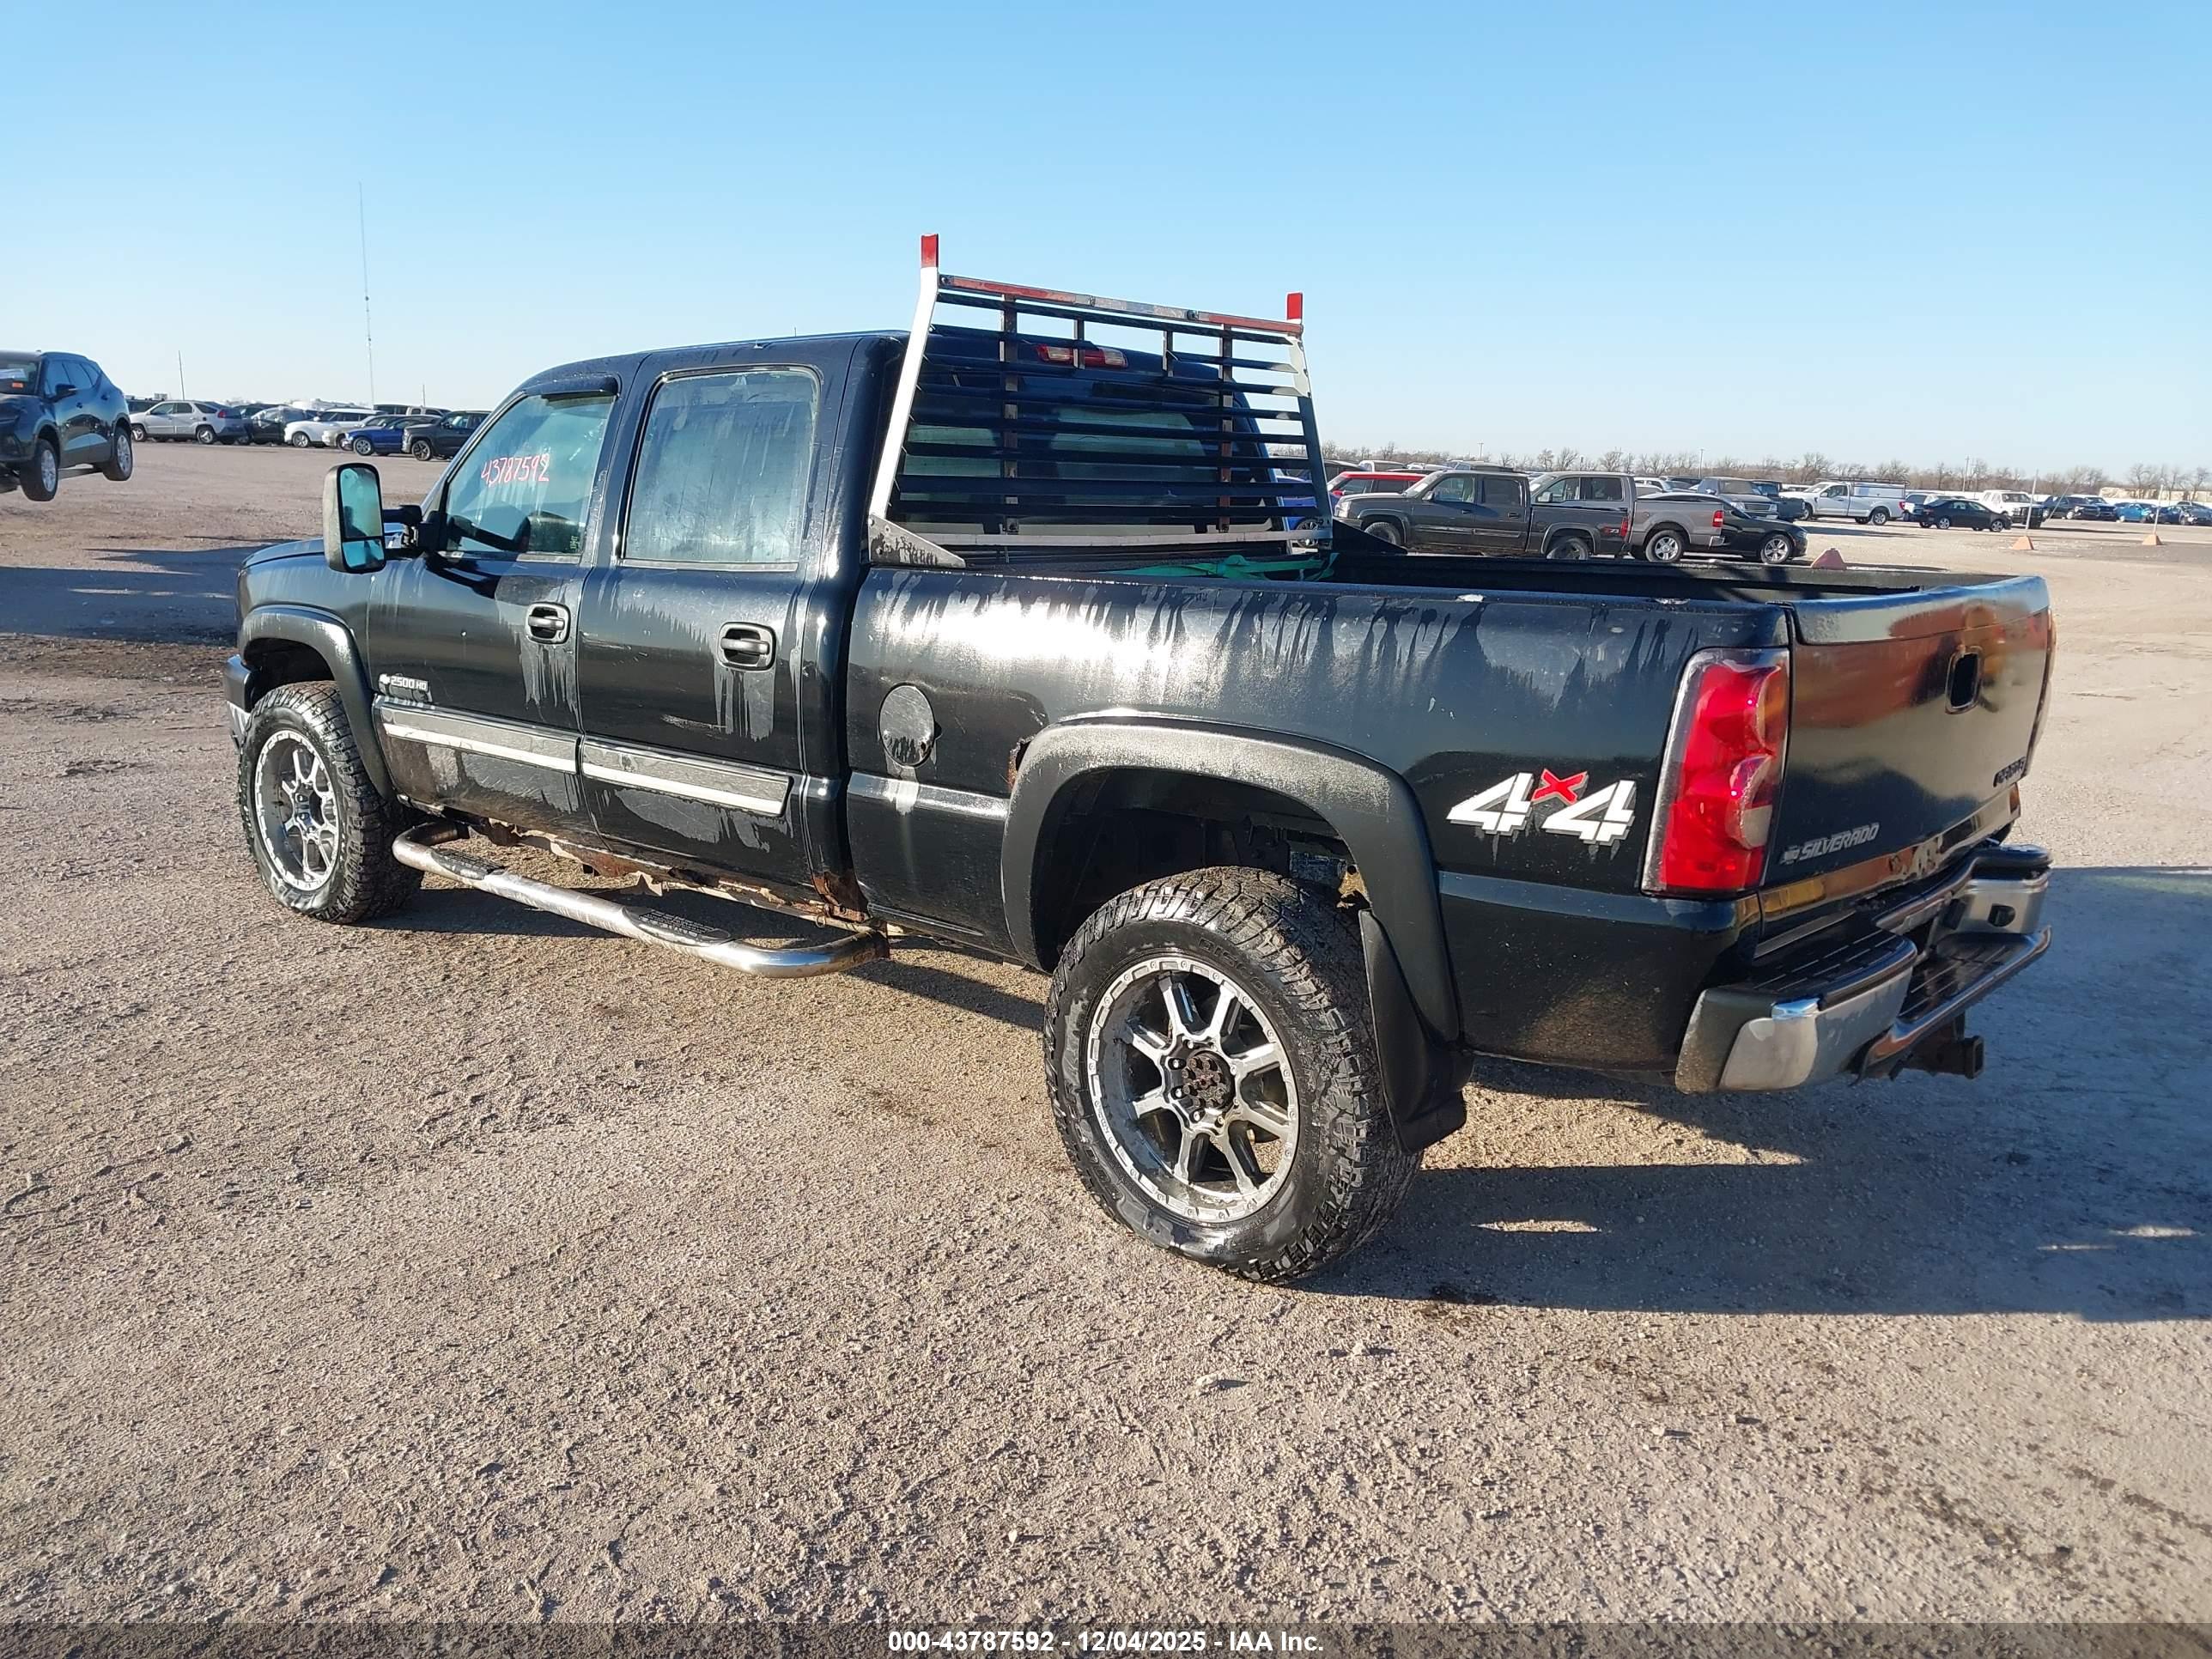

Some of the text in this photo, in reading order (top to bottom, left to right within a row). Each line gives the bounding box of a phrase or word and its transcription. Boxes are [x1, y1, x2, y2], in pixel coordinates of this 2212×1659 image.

[480, 453, 550, 488] 43787592
[390, 675, 428, 691] 2500 HD
[1798, 822, 1881, 861] SILVERADO
